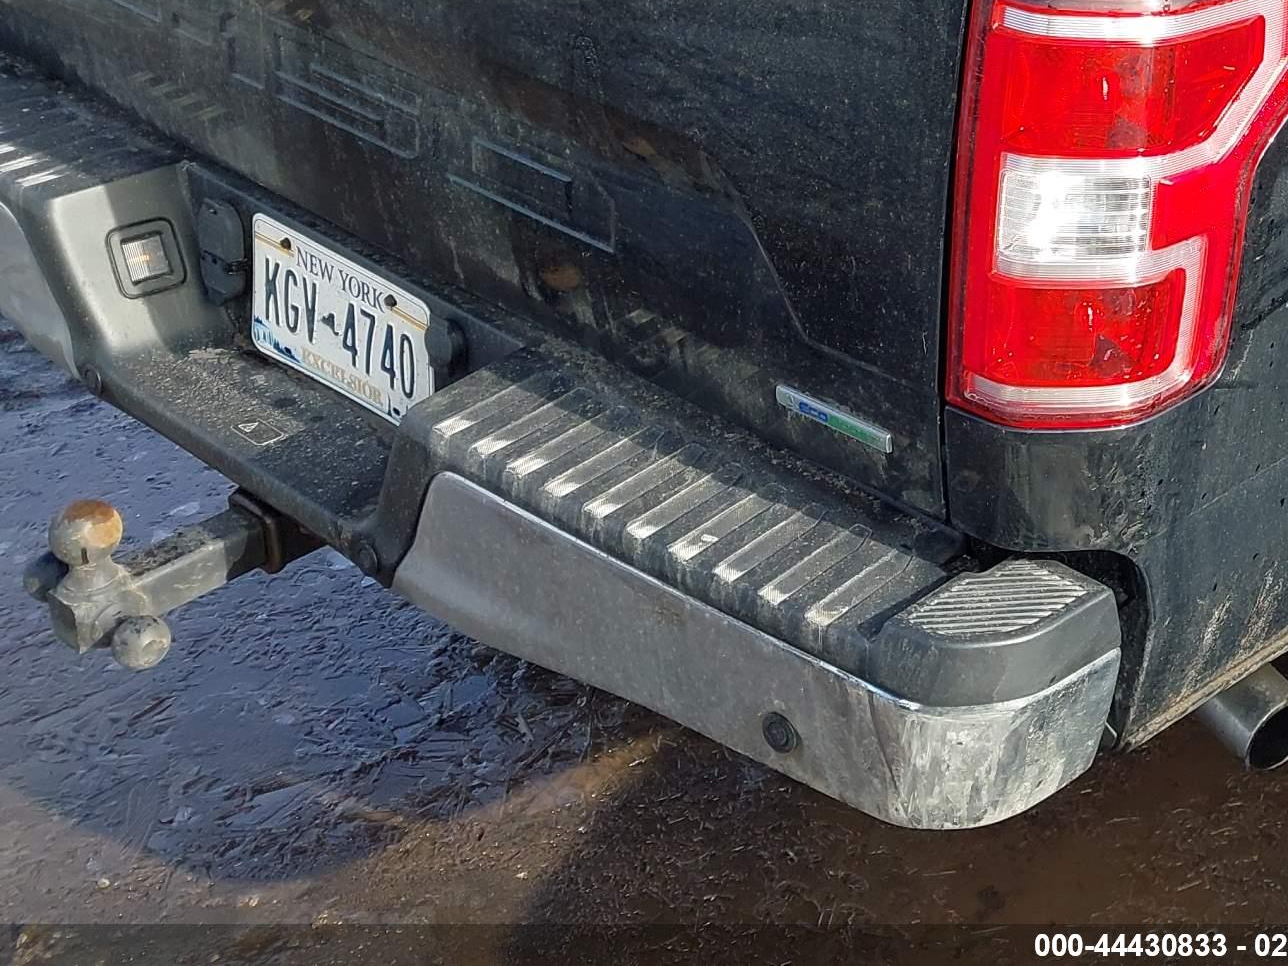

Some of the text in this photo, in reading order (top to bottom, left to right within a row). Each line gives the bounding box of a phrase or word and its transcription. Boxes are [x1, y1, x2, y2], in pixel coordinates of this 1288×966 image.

[296, 246, 385, 314] NEW YORK
[264, 257, 416, 399] KGV 4740
[302, 348, 383, 403] EXCELSIOR
